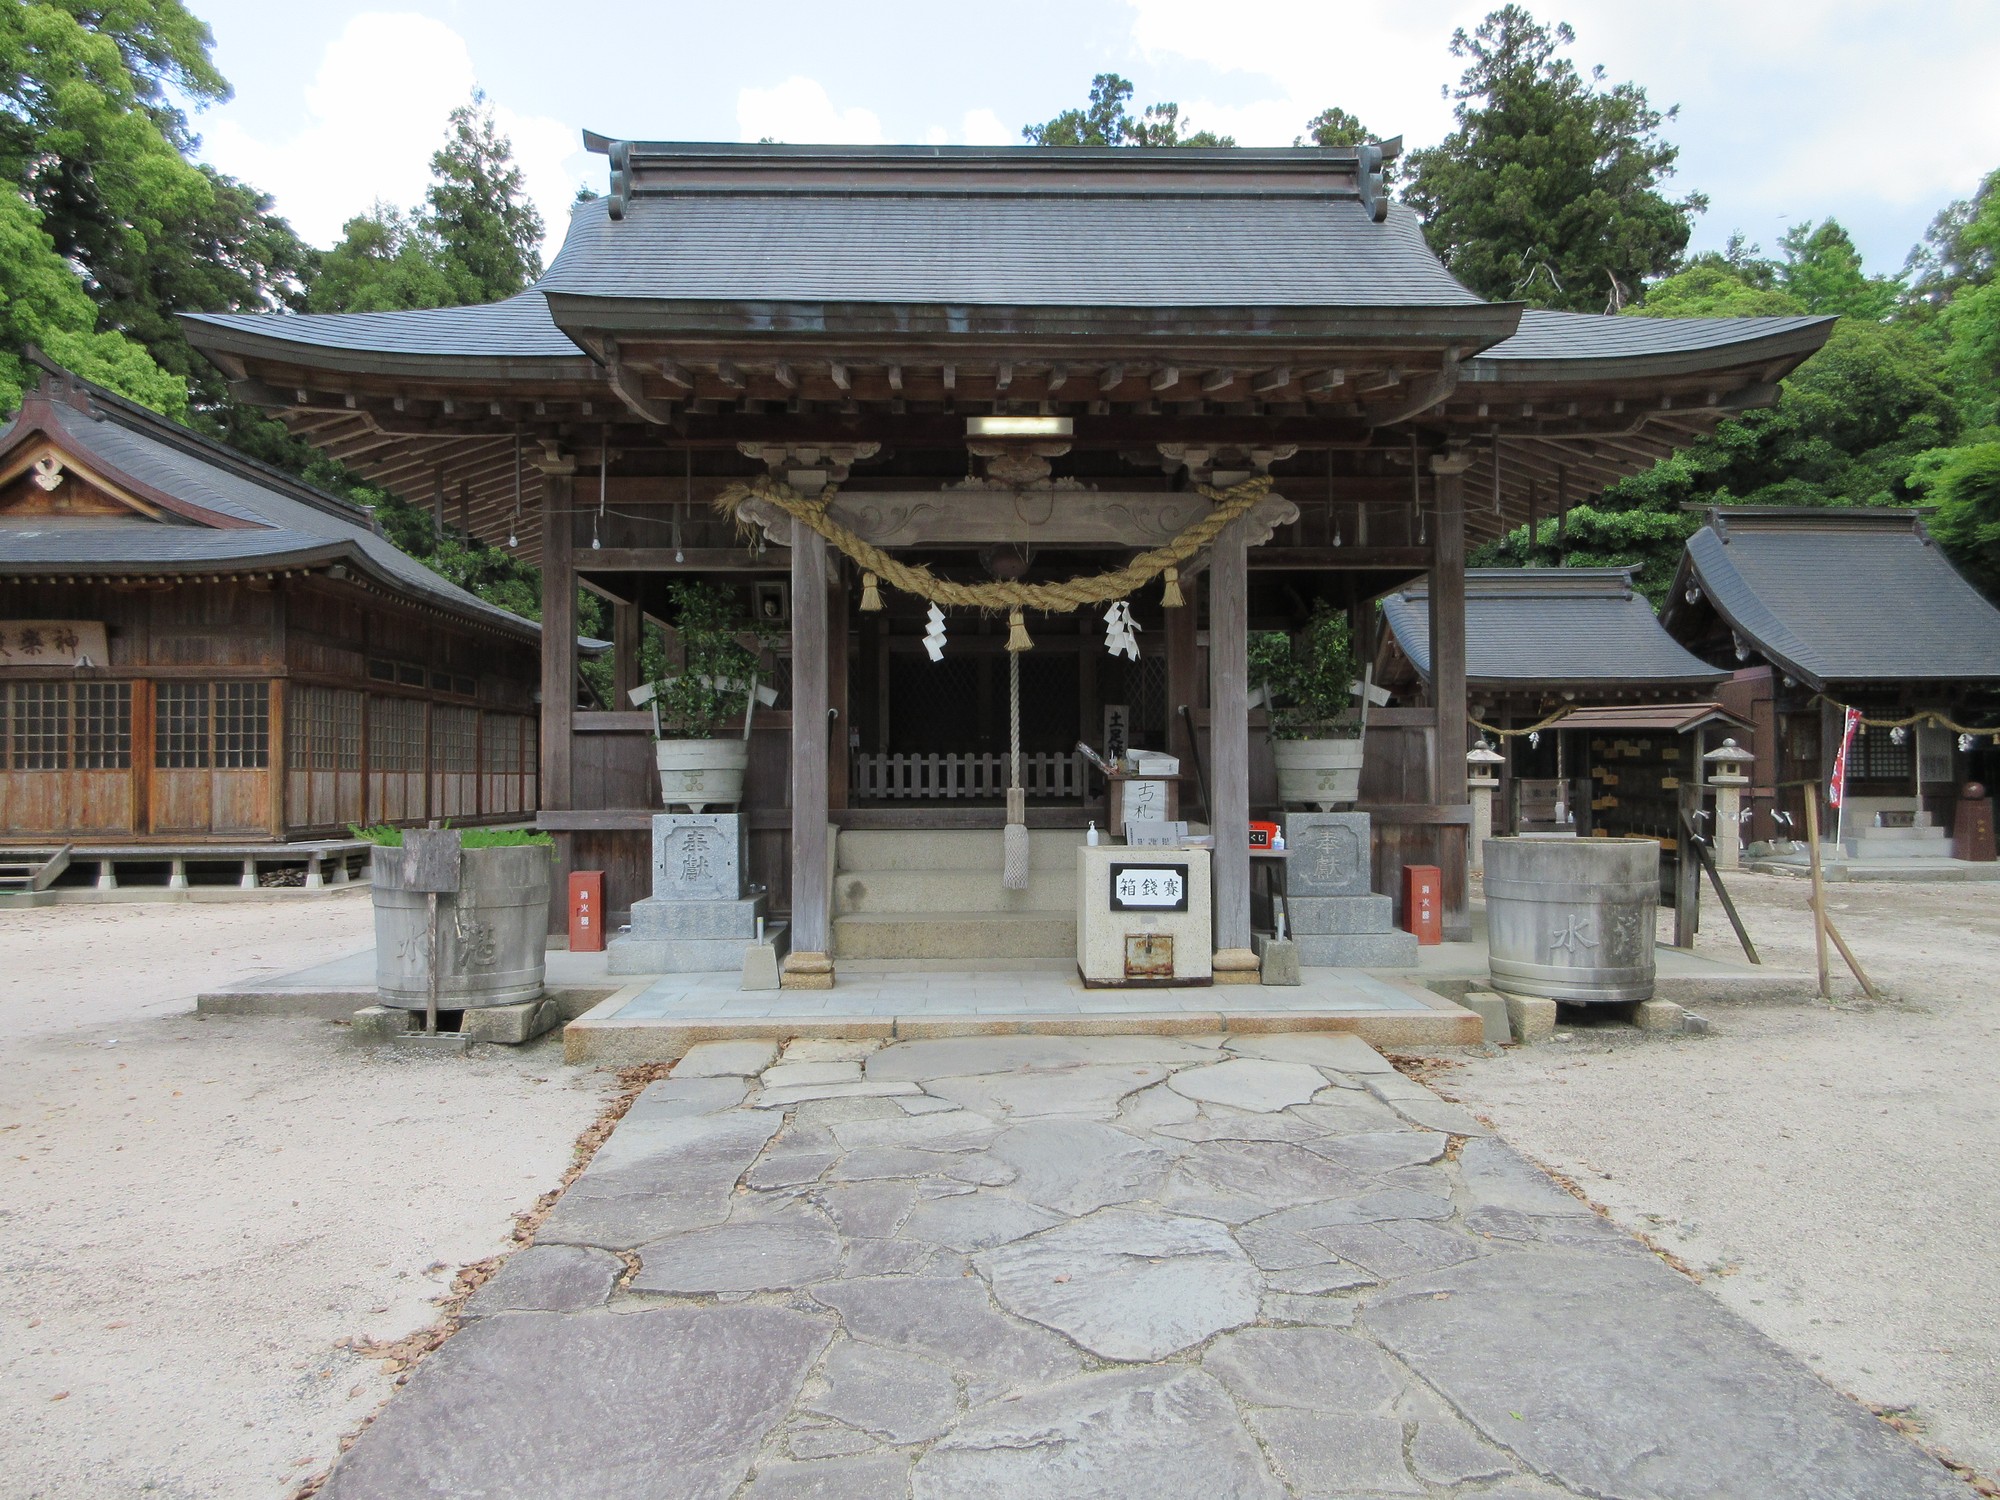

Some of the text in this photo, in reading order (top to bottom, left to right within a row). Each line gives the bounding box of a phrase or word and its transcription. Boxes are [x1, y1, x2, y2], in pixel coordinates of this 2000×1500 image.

[1134, 782, 1155, 822] 古札
[580, 890, 589, 925] 消火器
[1421, 885, 1430, 920] 消火器
